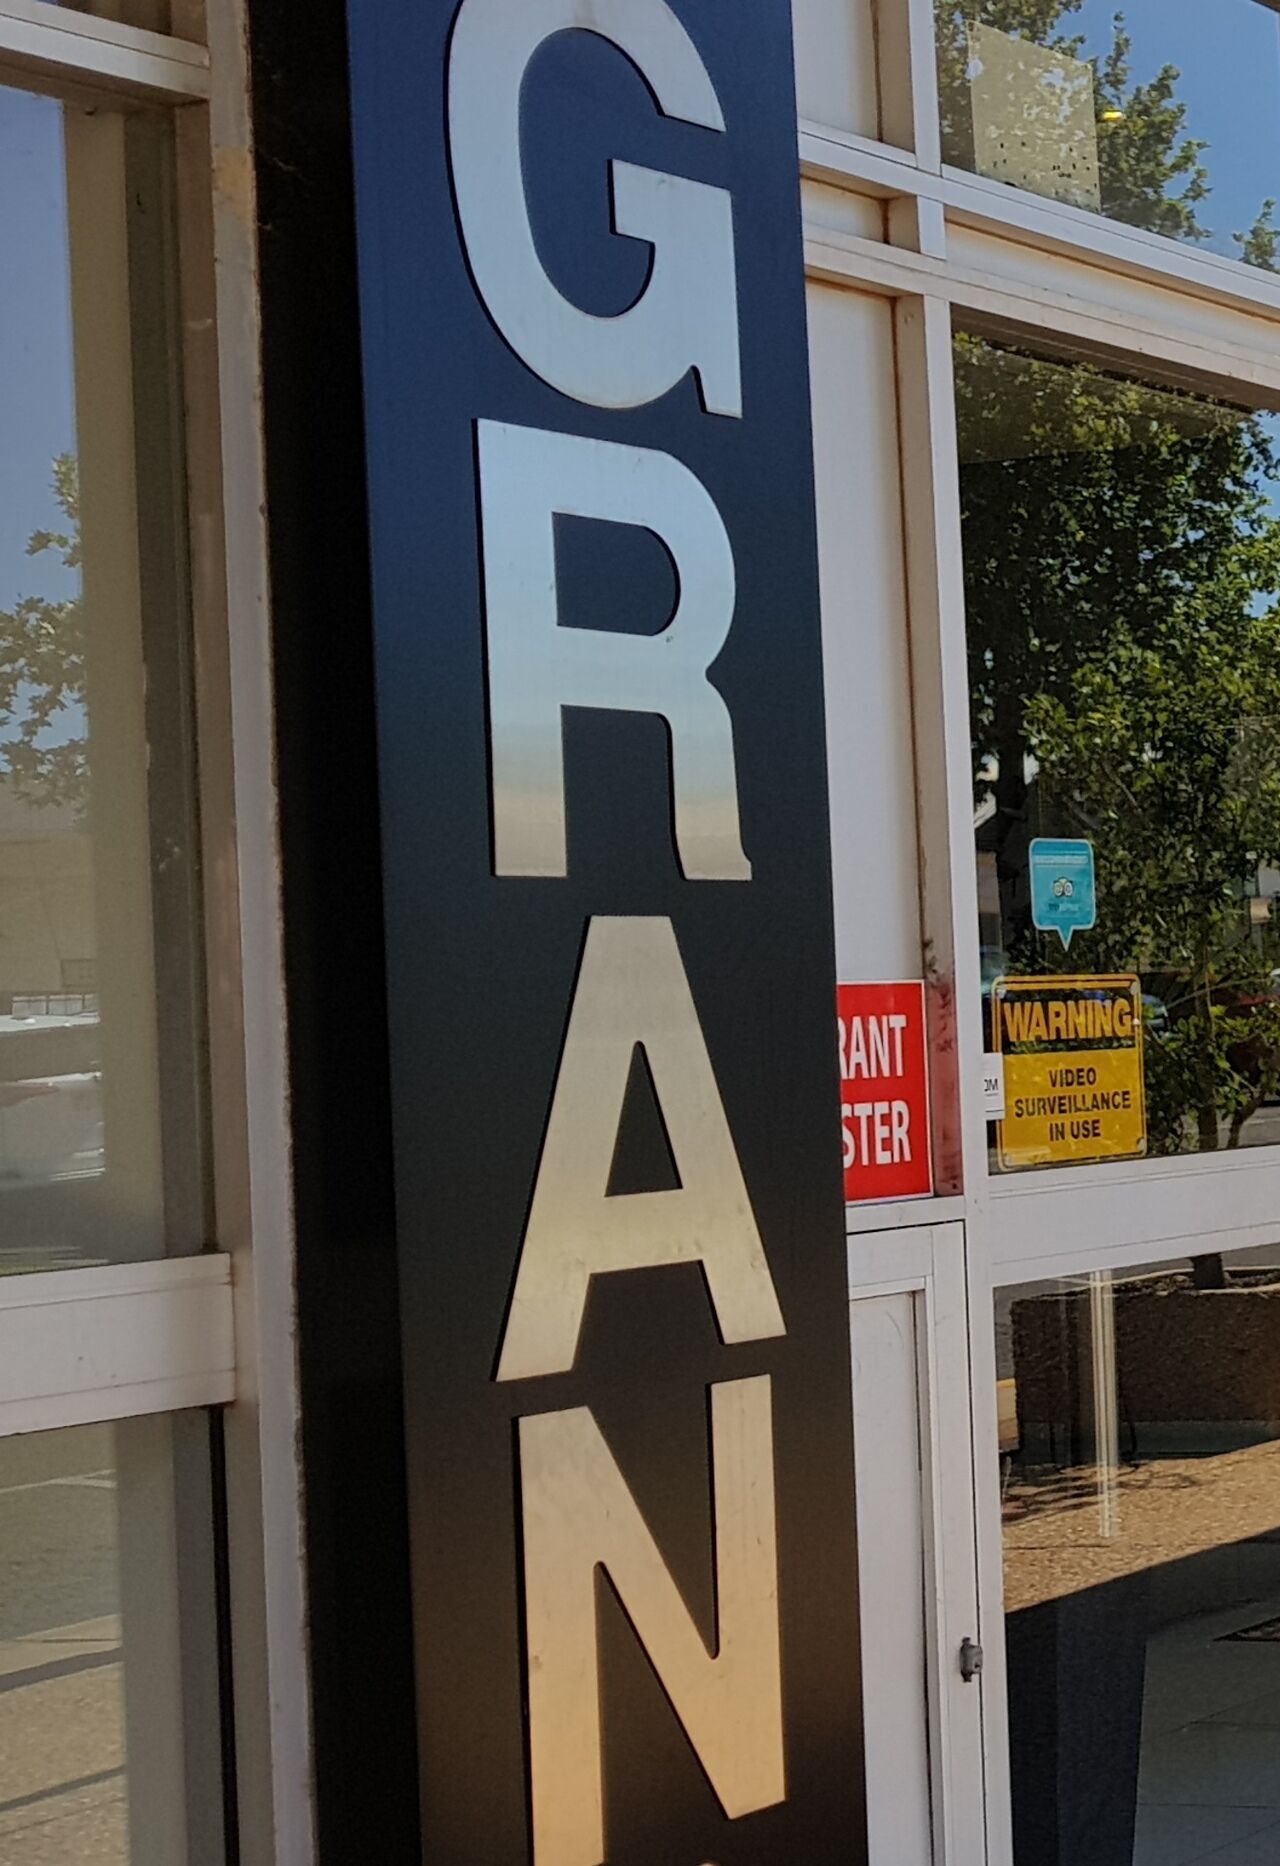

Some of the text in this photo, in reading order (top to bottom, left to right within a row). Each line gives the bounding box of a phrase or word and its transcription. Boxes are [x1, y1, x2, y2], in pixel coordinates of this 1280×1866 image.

[448, 0, 788, 1866] GRAN
[1003, 998, 1134, 1043] WARNING
[1049, 1066, 1097, 1088] VIDEO
[1014, 1090, 1132, 1118] SURVEILLANCE
[1049, 1119, 1102, 1142] IN USE
